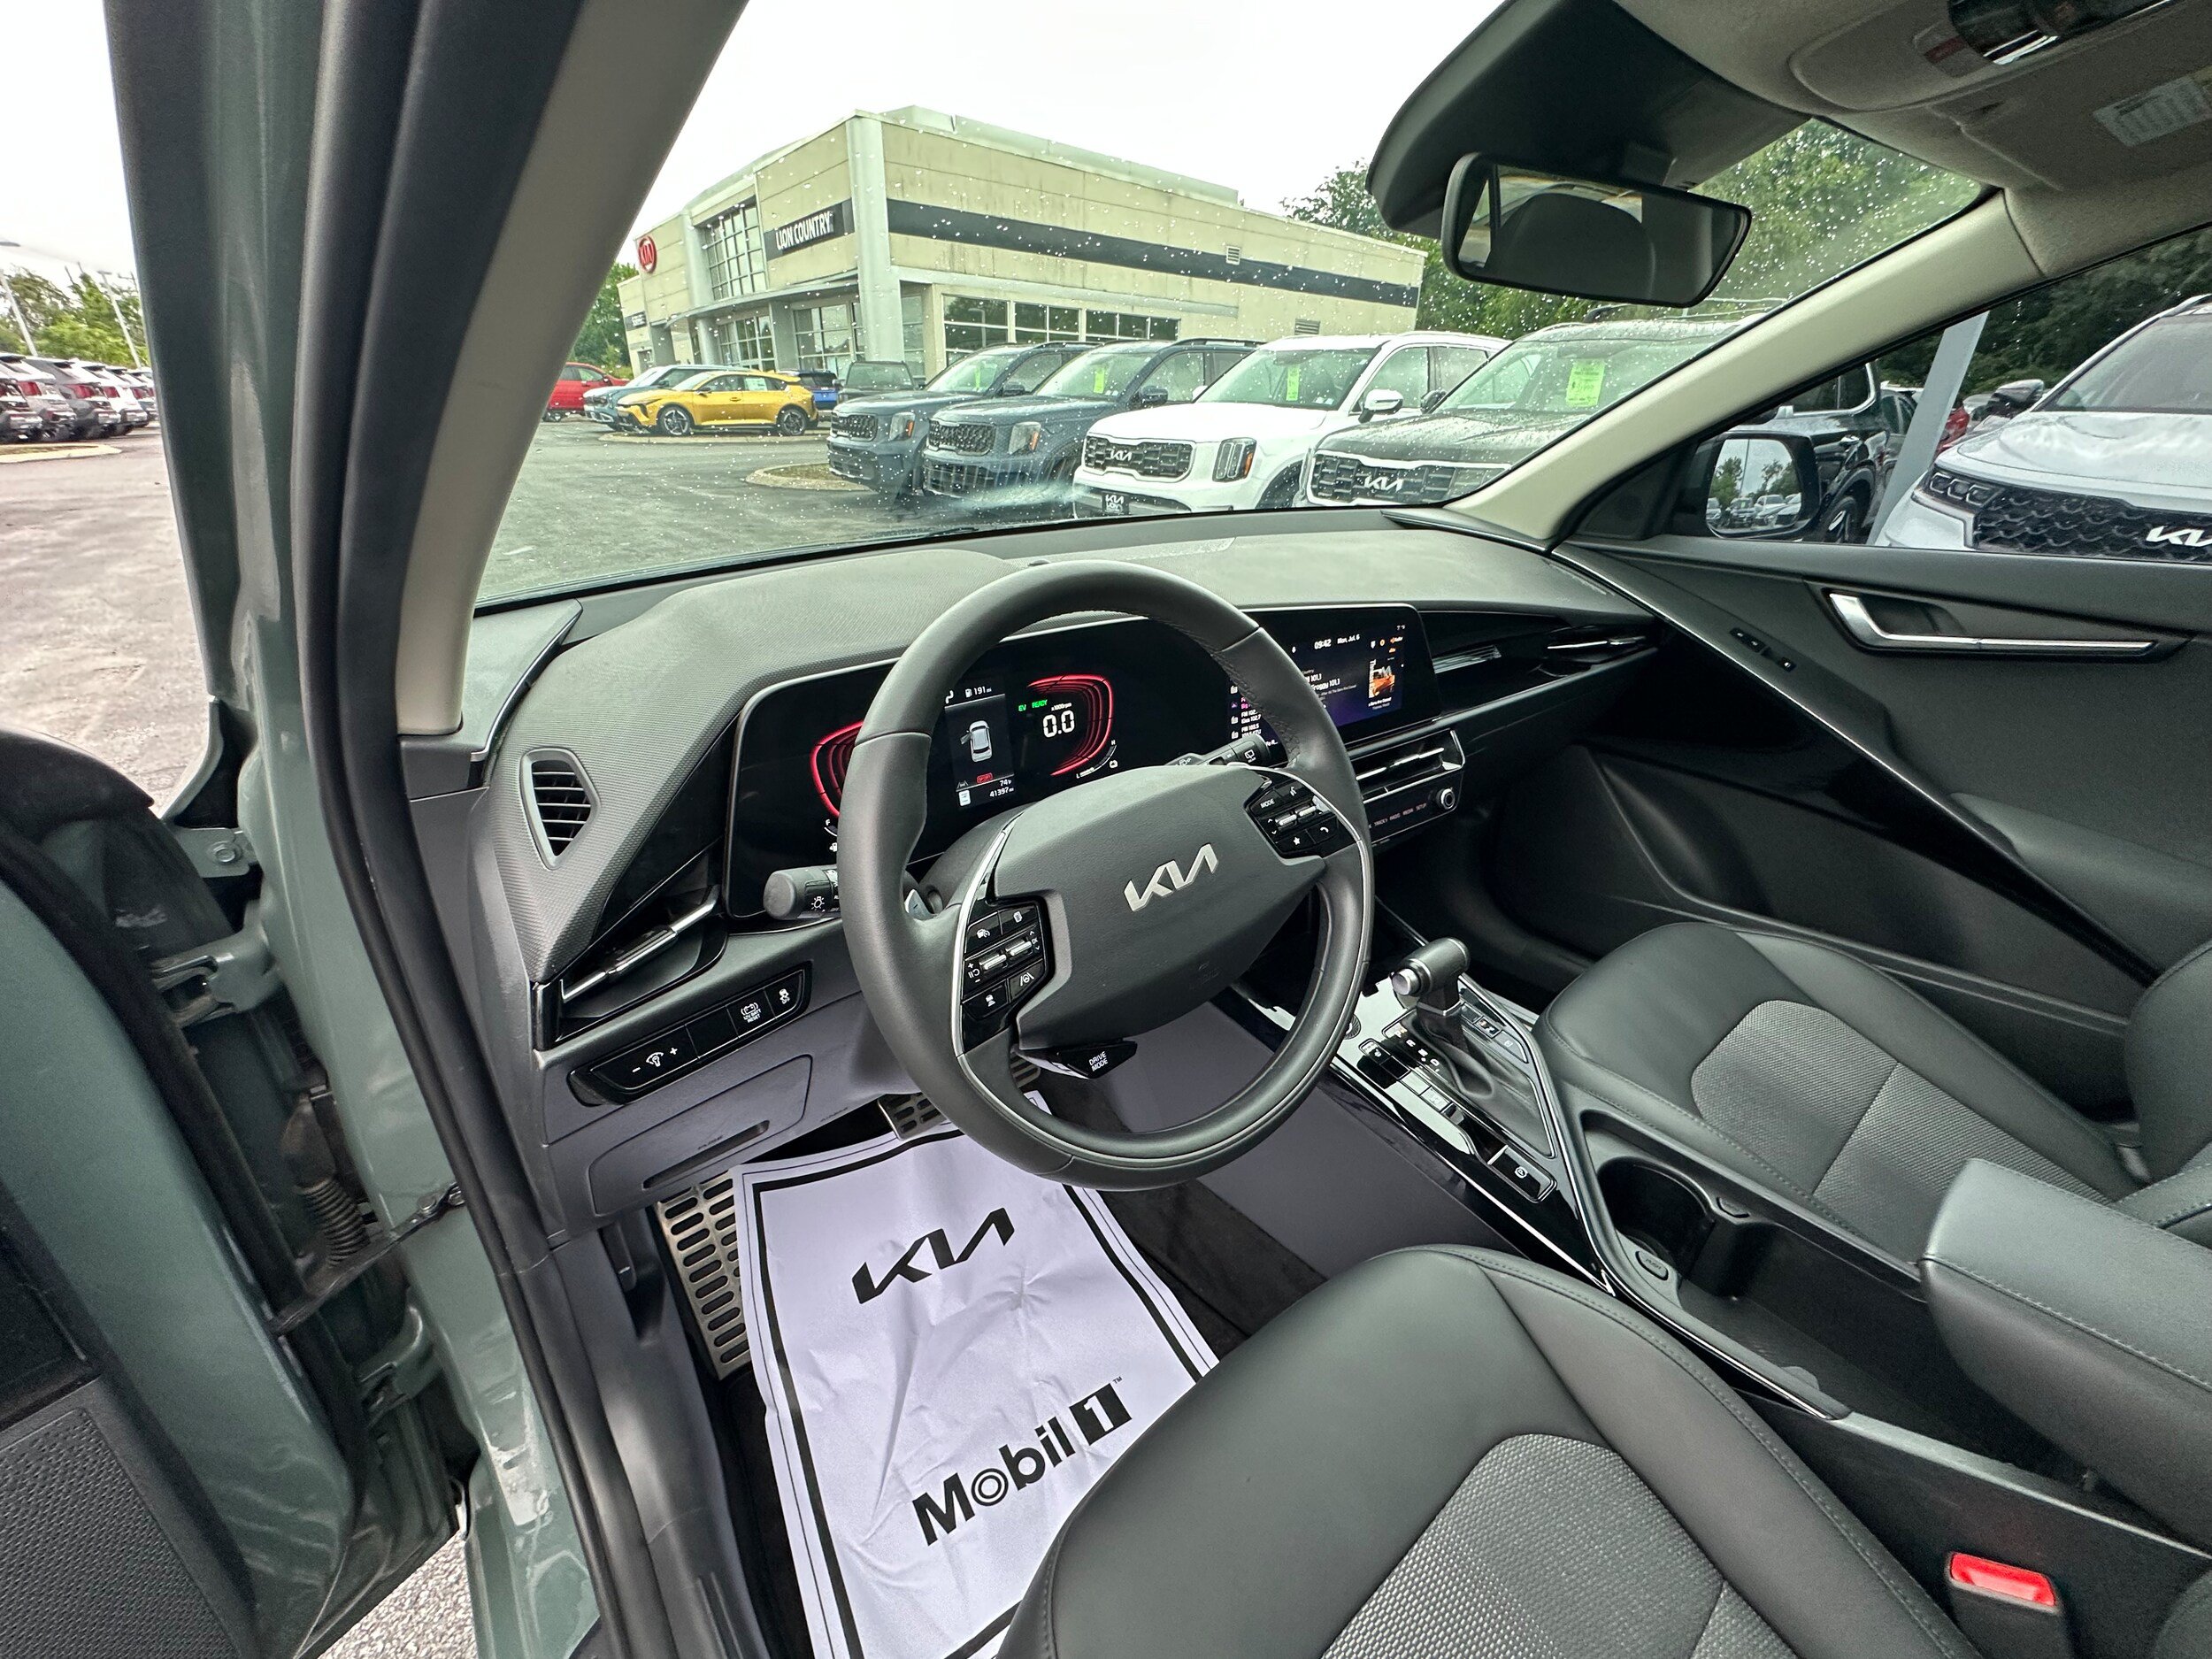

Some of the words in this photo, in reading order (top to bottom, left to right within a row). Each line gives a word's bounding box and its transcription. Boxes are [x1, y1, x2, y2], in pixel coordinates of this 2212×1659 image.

[776, 230, 795, 250] LION
[794, 211, 833, 245] COUNTRY
[1110, 449, 1133, 462] KIA
[1364, 474, 1404, 492] KIA
[1314, 639, 1332, 649] 09:42
[1032, 699, 1048, 709] READY
[1042, 710, 1075, 738] 0.0
[1260, 798, 1275, 809] MODE
[1123, 842, 1219, 912] KIA
[1088, 1050, 1107, 1066] DRIVE
[1091, 1057, 1109, 1072] MODE
[851, 1207, 1015, 1304] KIA
[911, 1416, 1076, 1547] Mobil
